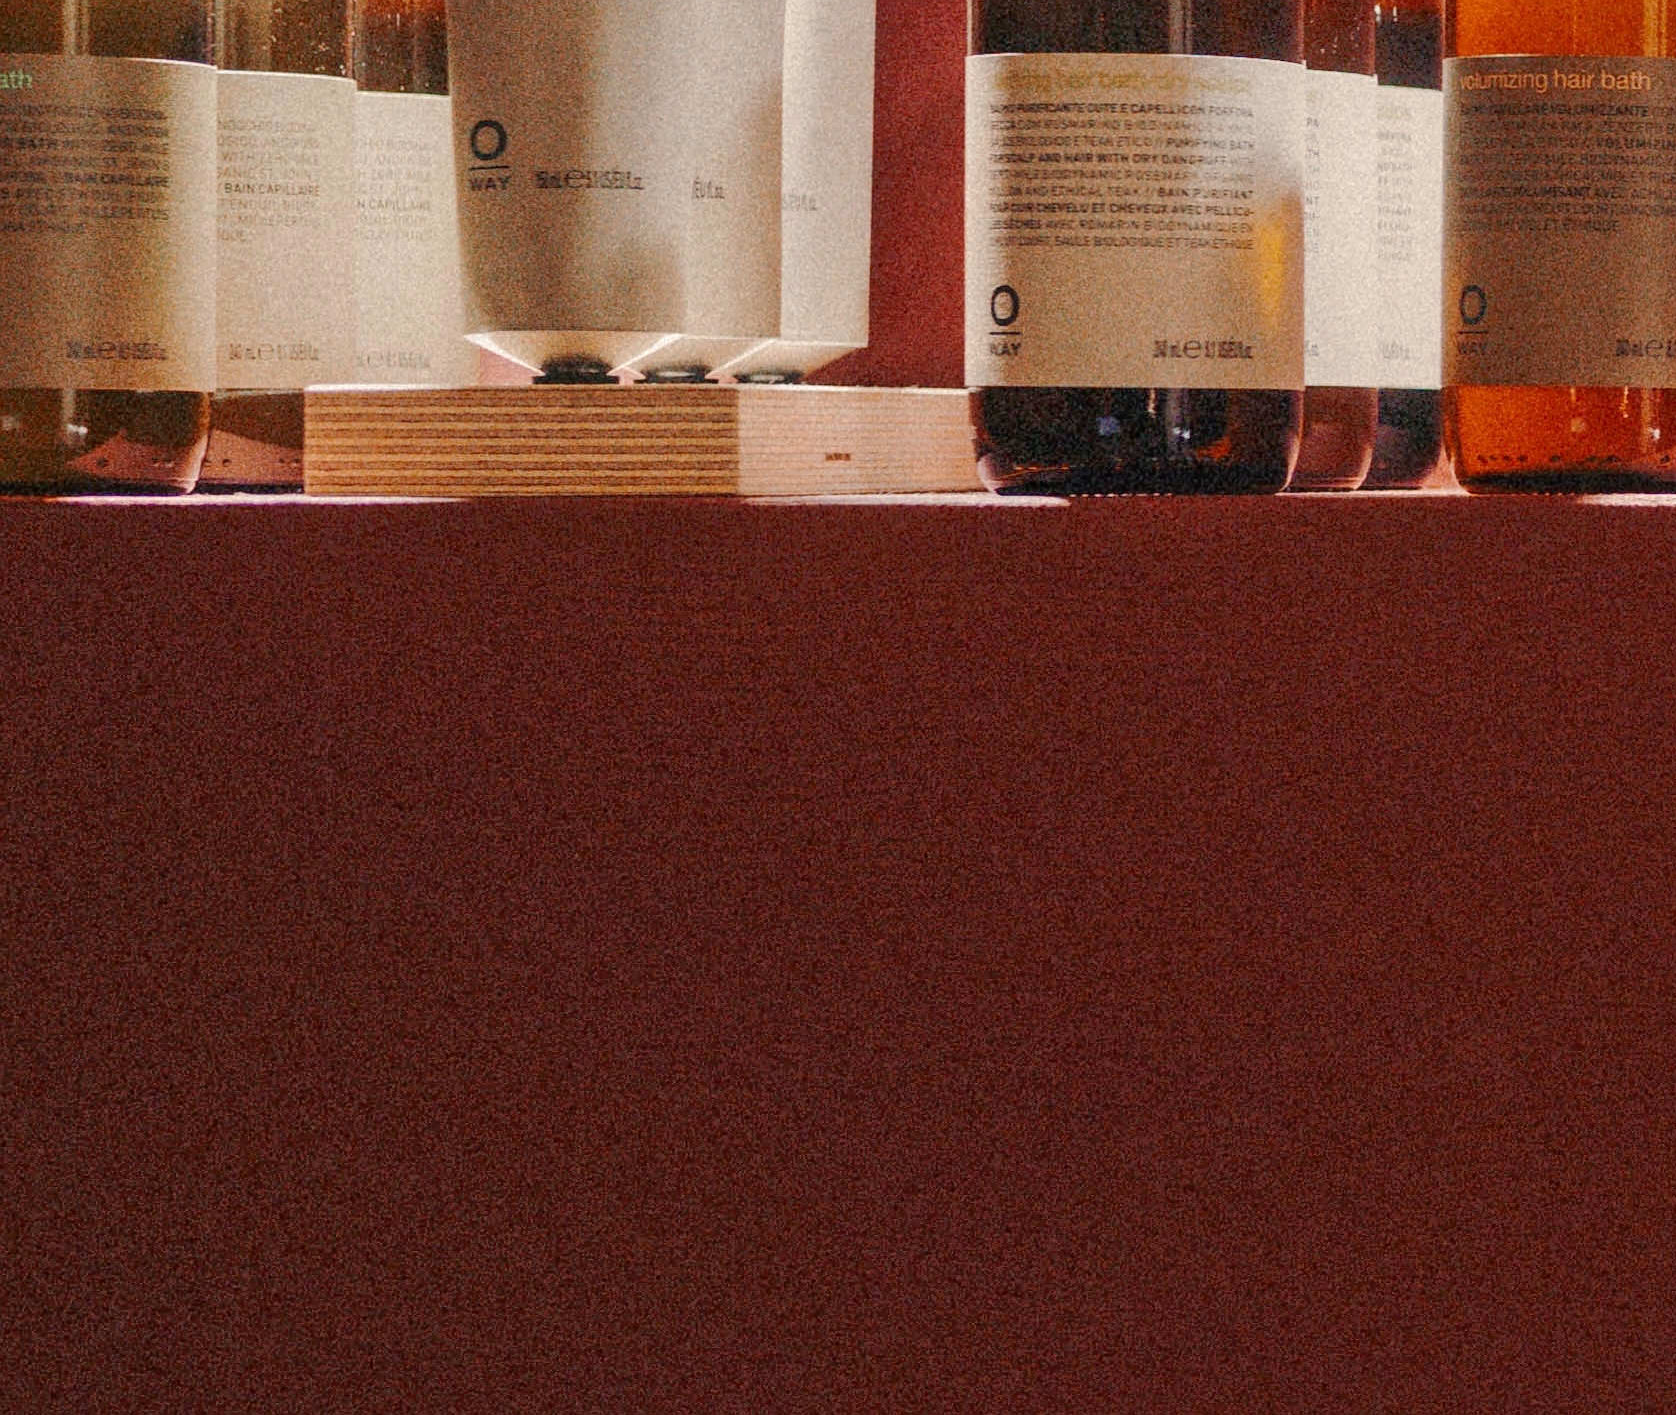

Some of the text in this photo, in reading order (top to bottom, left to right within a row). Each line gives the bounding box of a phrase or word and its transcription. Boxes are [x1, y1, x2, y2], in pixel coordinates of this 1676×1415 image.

[0, 69, 32, 89] ath
[1460, 69, 1651, 94] volumizing hair bath
[469, 118, 509, 162] O
[469, 176, 511, 191] WAY
[990, 284, 1021, 327] O
[1459, 284, 1487, 325] O
